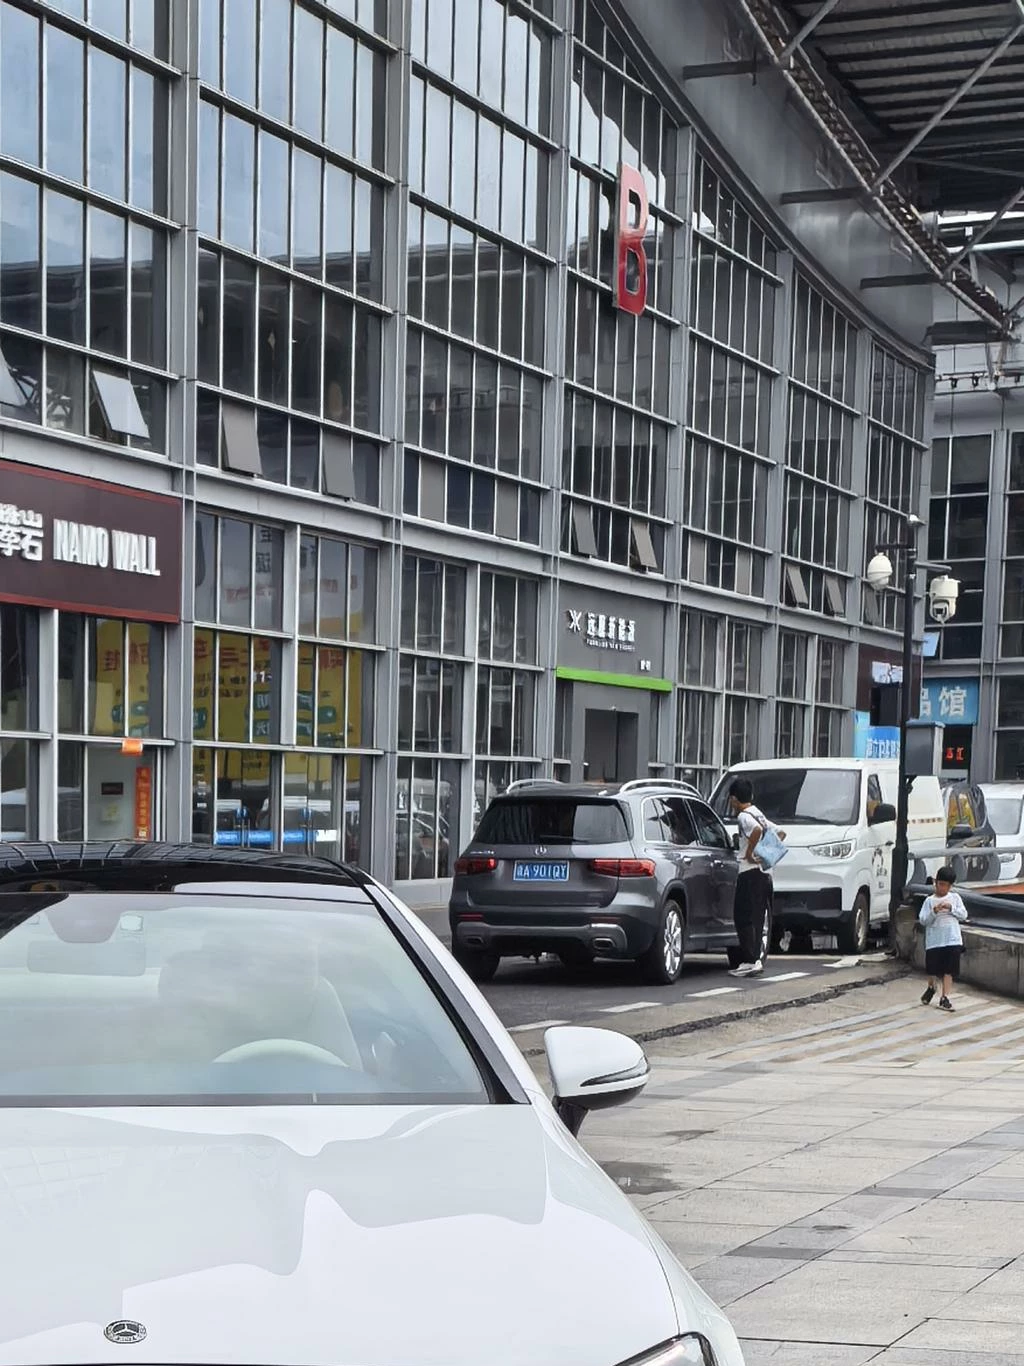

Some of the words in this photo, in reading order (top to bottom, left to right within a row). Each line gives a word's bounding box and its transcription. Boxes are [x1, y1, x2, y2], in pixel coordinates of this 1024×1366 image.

[616, 162, 649, 316] B
[53, 518, 109, 568] NAMO
[111, 529, 161, 576] WALL
